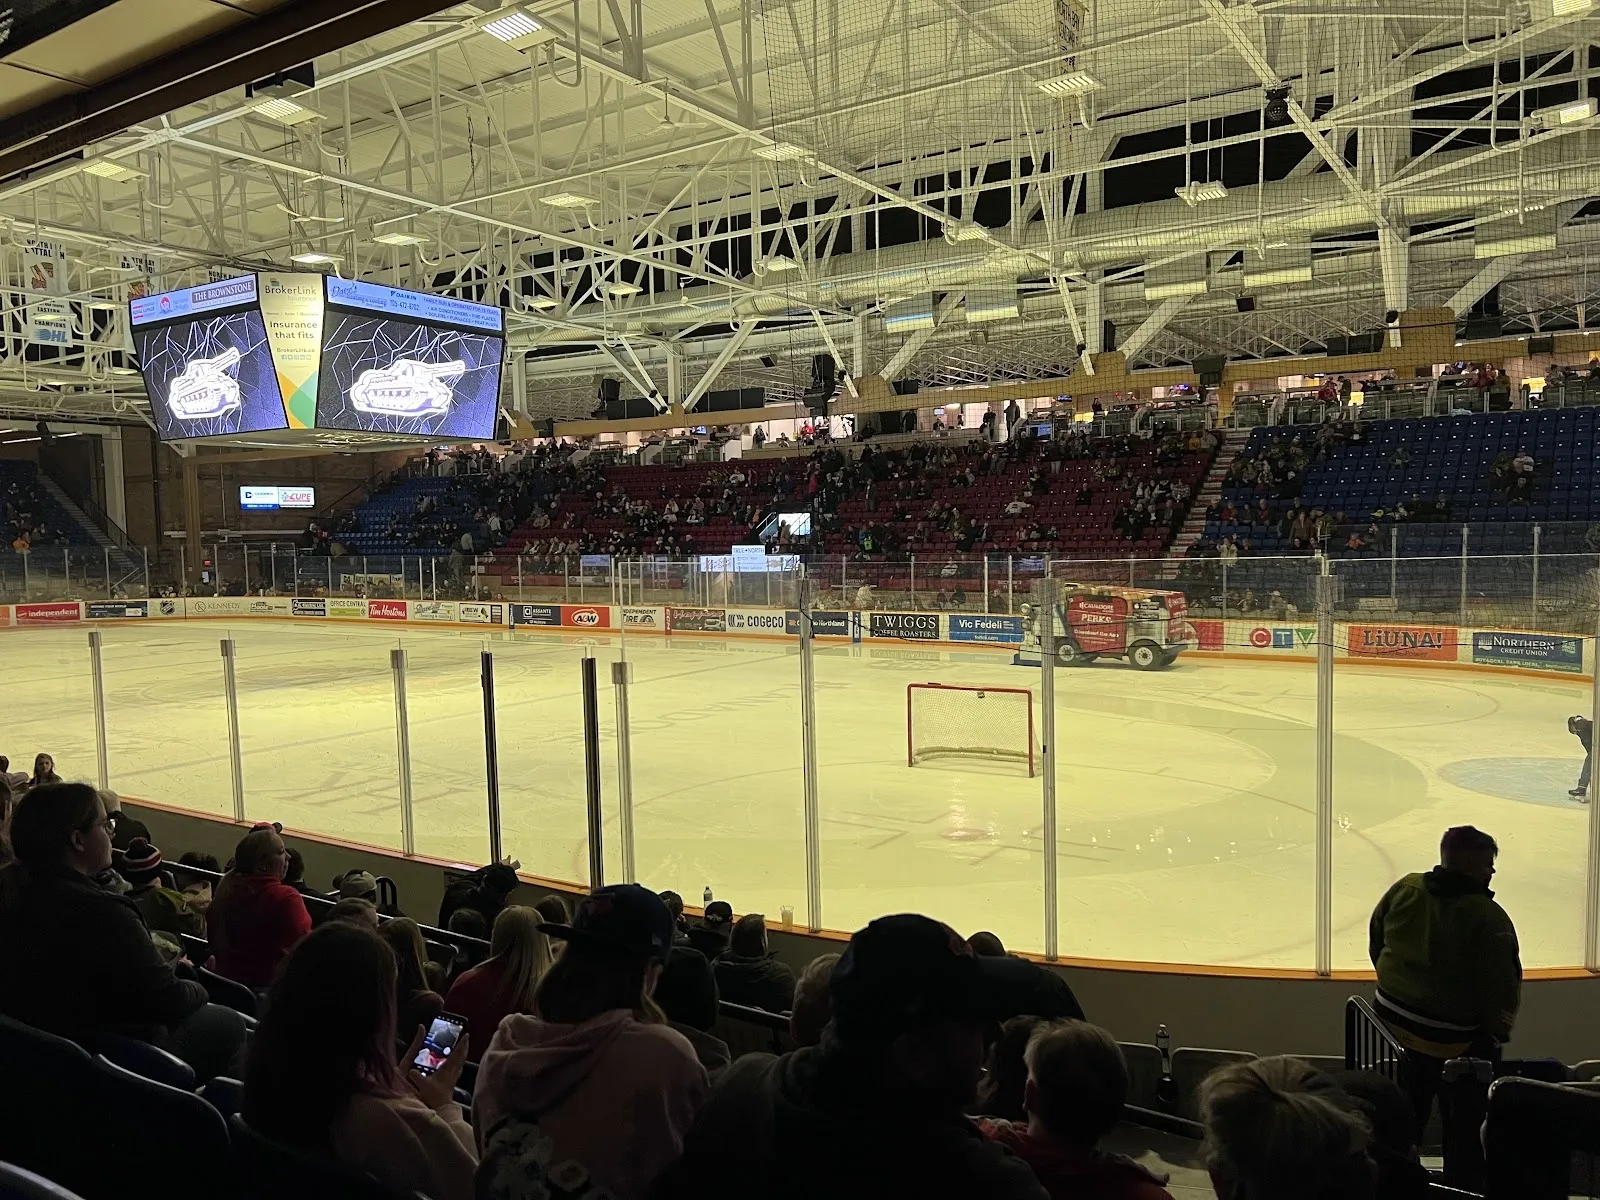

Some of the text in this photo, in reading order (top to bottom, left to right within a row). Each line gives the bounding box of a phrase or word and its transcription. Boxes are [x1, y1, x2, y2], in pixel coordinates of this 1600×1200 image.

[194, 291, 208, 302] THE
[207, 281, 252, 299] BROWNSTONE
[265, 285, 317, 295] BrokerLink
[395, 292, 417, 301] DAIKIN
[269, 321, 318, 329] Insurance
[275, 331, 315, 339] that fits
[207, 602, 240, 610] KENNEDY
[330, 600, 366, 608] OFFICE CENTRAL
[1083, 602, 1114, 611] CANADORE
[28, 608, 78, 618] independent
[369, 604, 406, 618] Tim Hortons
[576, 615, 597, 623] A&W
[818, 619, 845, 627] Northland
[873, 615, 936, 629] TWIGGS
[958, 619, 973, 629] Vic
[974, 619, 1002, 630] Fedeli
[873, 629, 936, 639] COFFEE ROASTERS
[1252, 629, 1315, 646] CTV
[1363, 629, 1442, 649] LiUNA!
[1500, 647, 1548, 657] CREDIT UNION
